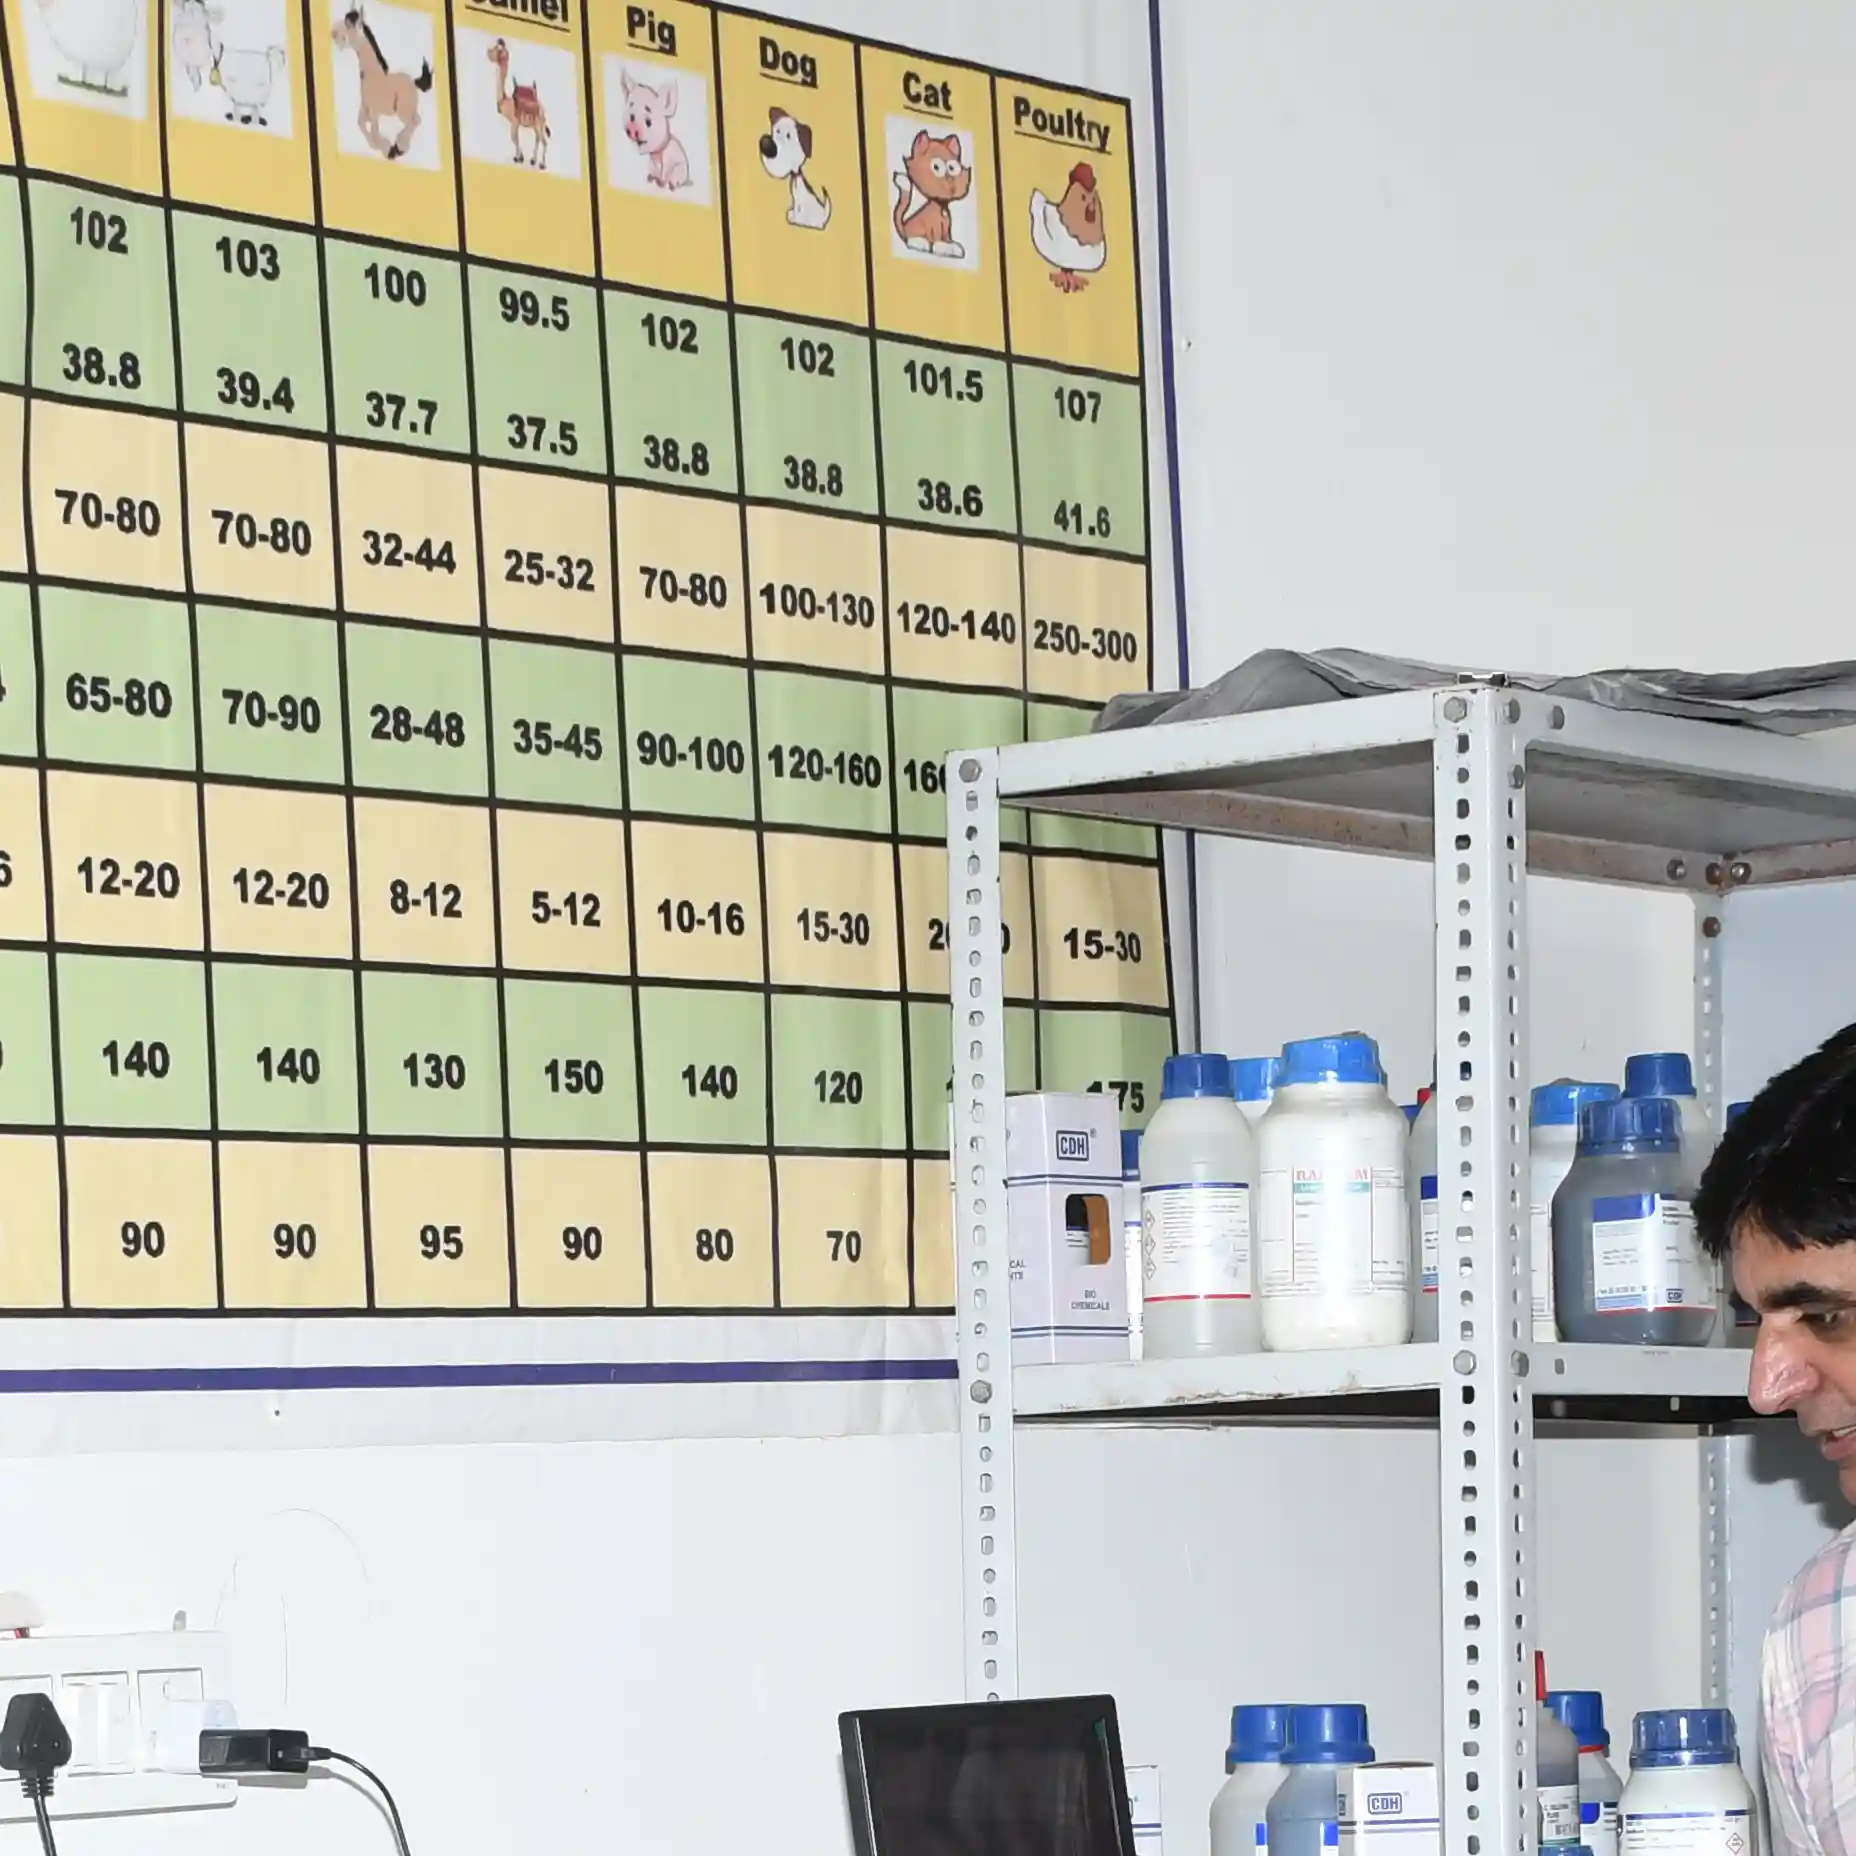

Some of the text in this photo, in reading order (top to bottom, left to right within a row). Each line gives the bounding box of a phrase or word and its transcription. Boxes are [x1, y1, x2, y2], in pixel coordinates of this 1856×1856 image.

[627, 6, 677, 53] Pig
[760, 37, 818, 86] Dog
[903, 71, 952, 112] Cat
[1014, 96, 1111, 149] Poultry
[71, 206, 128, 254] 102
[216, 236, 280, 281] 103
[365, 263, 426, 306] 100
[500, 287, 569, 331] 99.5
[642, 313, 698, 354] 102
[63, 343, 141, 389] 38.8
[781, 337, 834, 377] 102
[217, 367, 294, 413] 39.4
[904, 360, 983, 402] 101.5
[366, 391, 437, 435] 37.7
[1055, 387, 1101, 423] 107
[507, 414, 577, 456] 37.5
[644, 435, 709, 476] 38.8
[784, 455, 843, 497] 38.8
[55, 489, 160, 536] 70-80
[918, 478, 983, 516] 38.6
[212, 510, 311, 556] 70-80
[1054, 500, 1110, 537] 41.6
[363, 530, 456, 574] 32-44
[505, 549, 594, 591] 25-32
[640, 566, 727, 608] 70-80
[760, 583, 874, 628] 100-130
[897, 602, 1015, 644] 120-140
[1034, 620, 1137, 662] 250-300
[67, 673, 172, 718] 65-80
[222, 689, 320, 733] 70-90
[370, 704, 465, 747] 28-48
[513, 719, 602, 760] 35-45
[637, 731, 744, 774] 90-100
[768, 745, 881, 788] 120-160
[78, 857, 180, 898] 12-20
[234, 868, 329, 908] 12-20
[390, 879, 462, 918] 8-12
[532, 891, 600, 927] 5-12
[658, 899, 744, 936] 10-16
[798, 908, 869, 945] 15-30
[1064, 928, 1141, 963] 15-30
[103, 1040, 169, 1078] 140
[257, 1047, 320, 1084] 140
[404, 1053, 465, 1089] 130
[545, 1059, 603, 1094] 150
[682, 1064, 737, 1099] 140
[815, 1071, 862, 1104] 120
[1059, 1136, 1086, 1156] CDH
[122, 1222, 164, 1258] 90
[274, 1224, 316, 1259] 90
[420, 1225, 463, 1259] 95
[563, 1227, 602, 1260] 90
[696, 1229, 733, 1261] 80
[827, 1231, 861, 1262] 70
[1371, 1797, 1399, 1810] CDH
